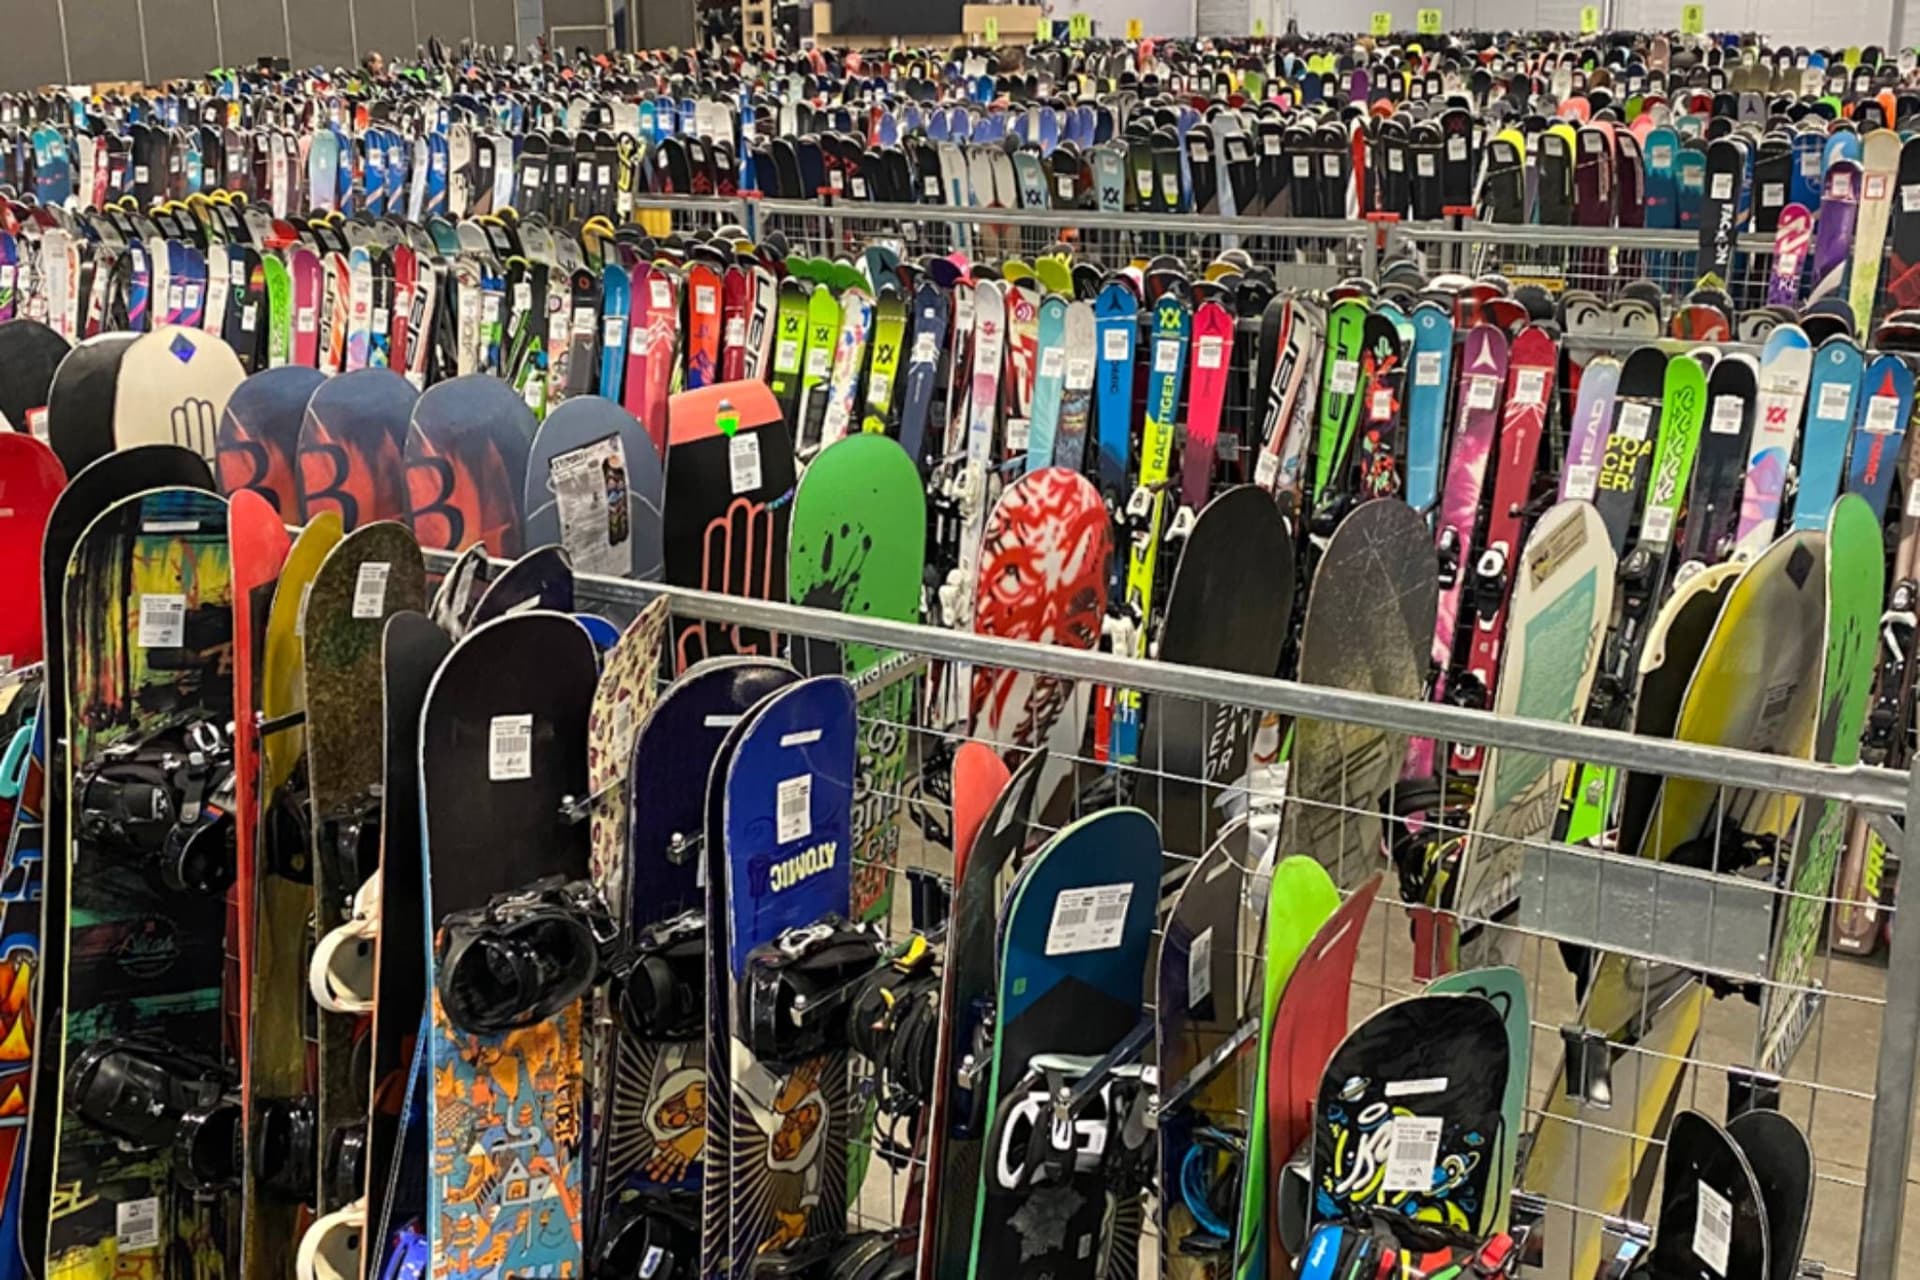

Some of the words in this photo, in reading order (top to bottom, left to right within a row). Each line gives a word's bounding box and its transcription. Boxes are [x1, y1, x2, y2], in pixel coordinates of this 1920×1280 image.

[1153, 374, 1177, 471] RACETIGER
[1603, 454, 1636, 474] CH
[770, 840, 837, 893] ATOMIC
